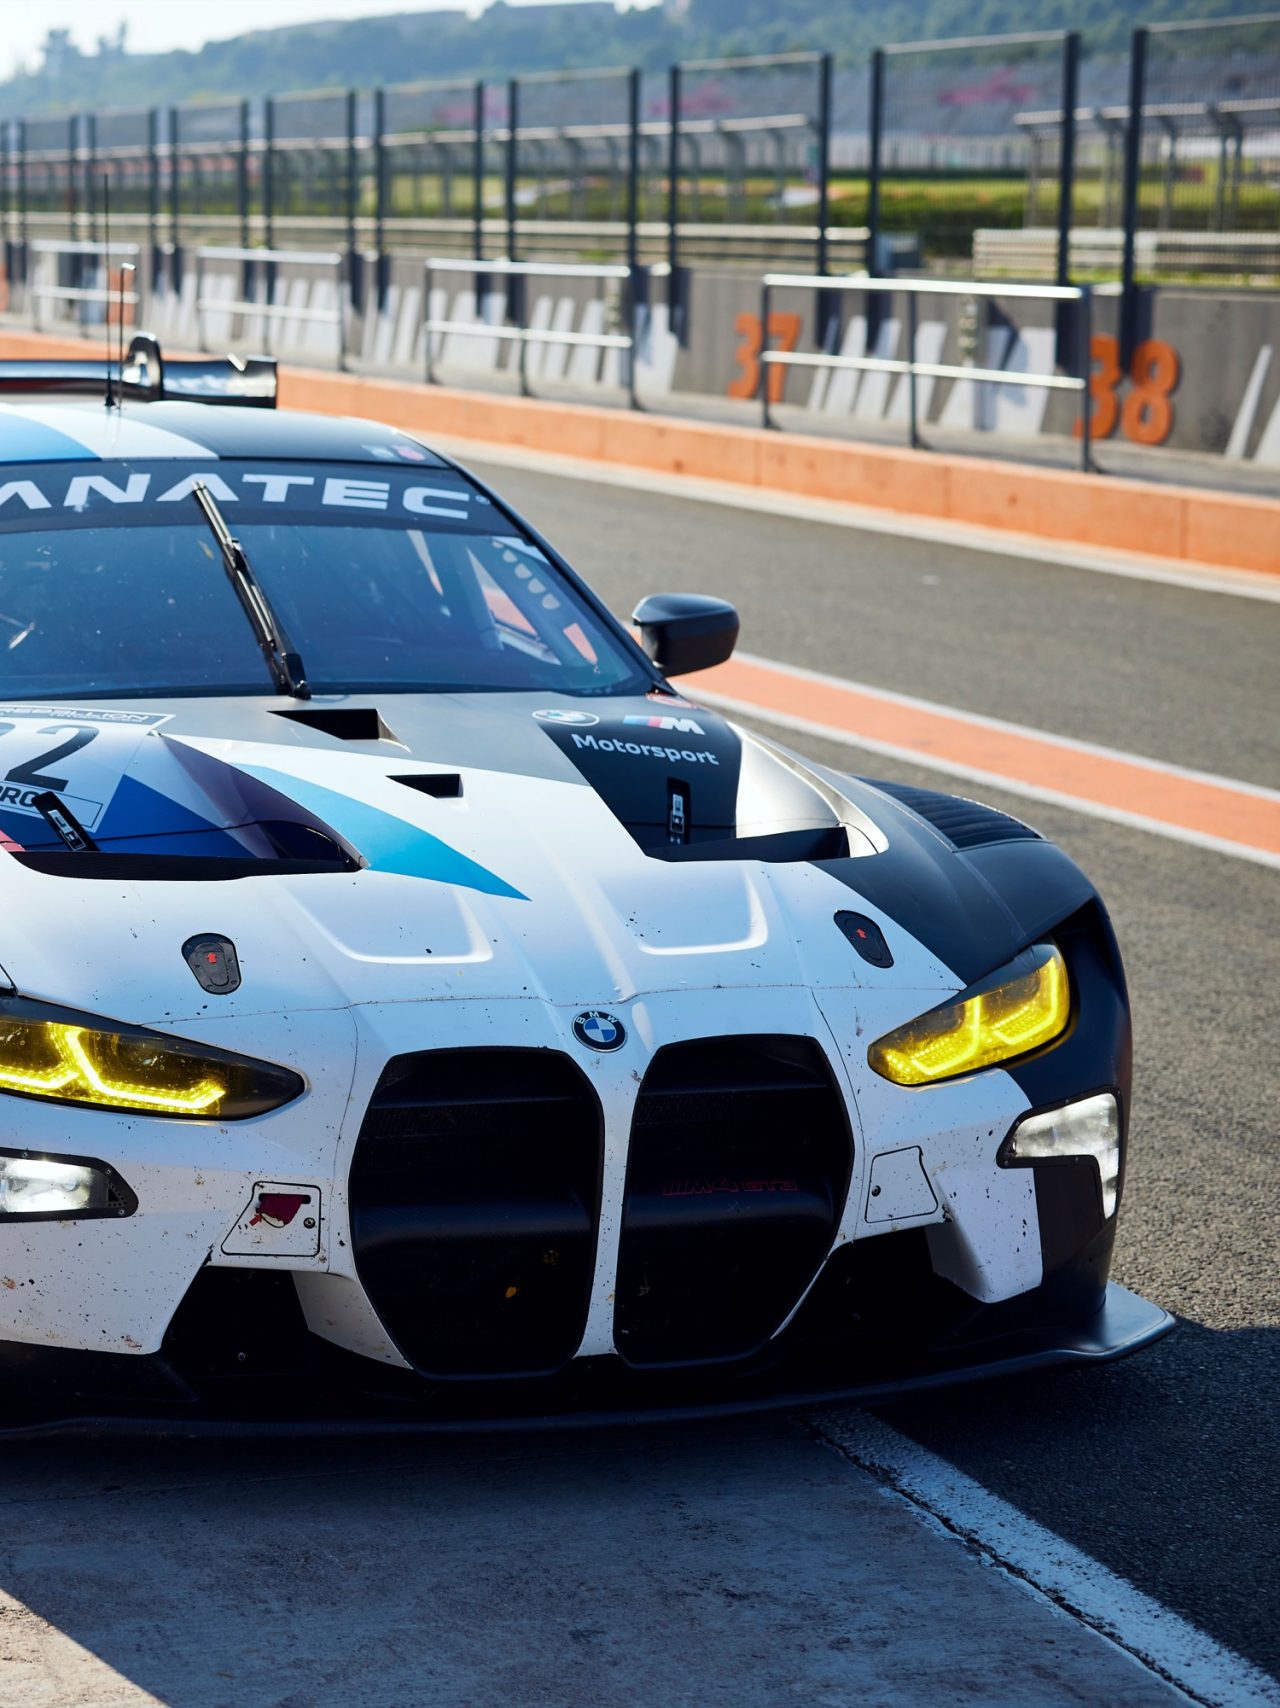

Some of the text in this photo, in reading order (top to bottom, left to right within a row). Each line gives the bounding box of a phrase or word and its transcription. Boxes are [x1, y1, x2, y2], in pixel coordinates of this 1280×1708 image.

[727, 312, 801, 404] 37
[1073, 333, 1181, 446] 38
[571, 733, 720, 766] Motorsport
